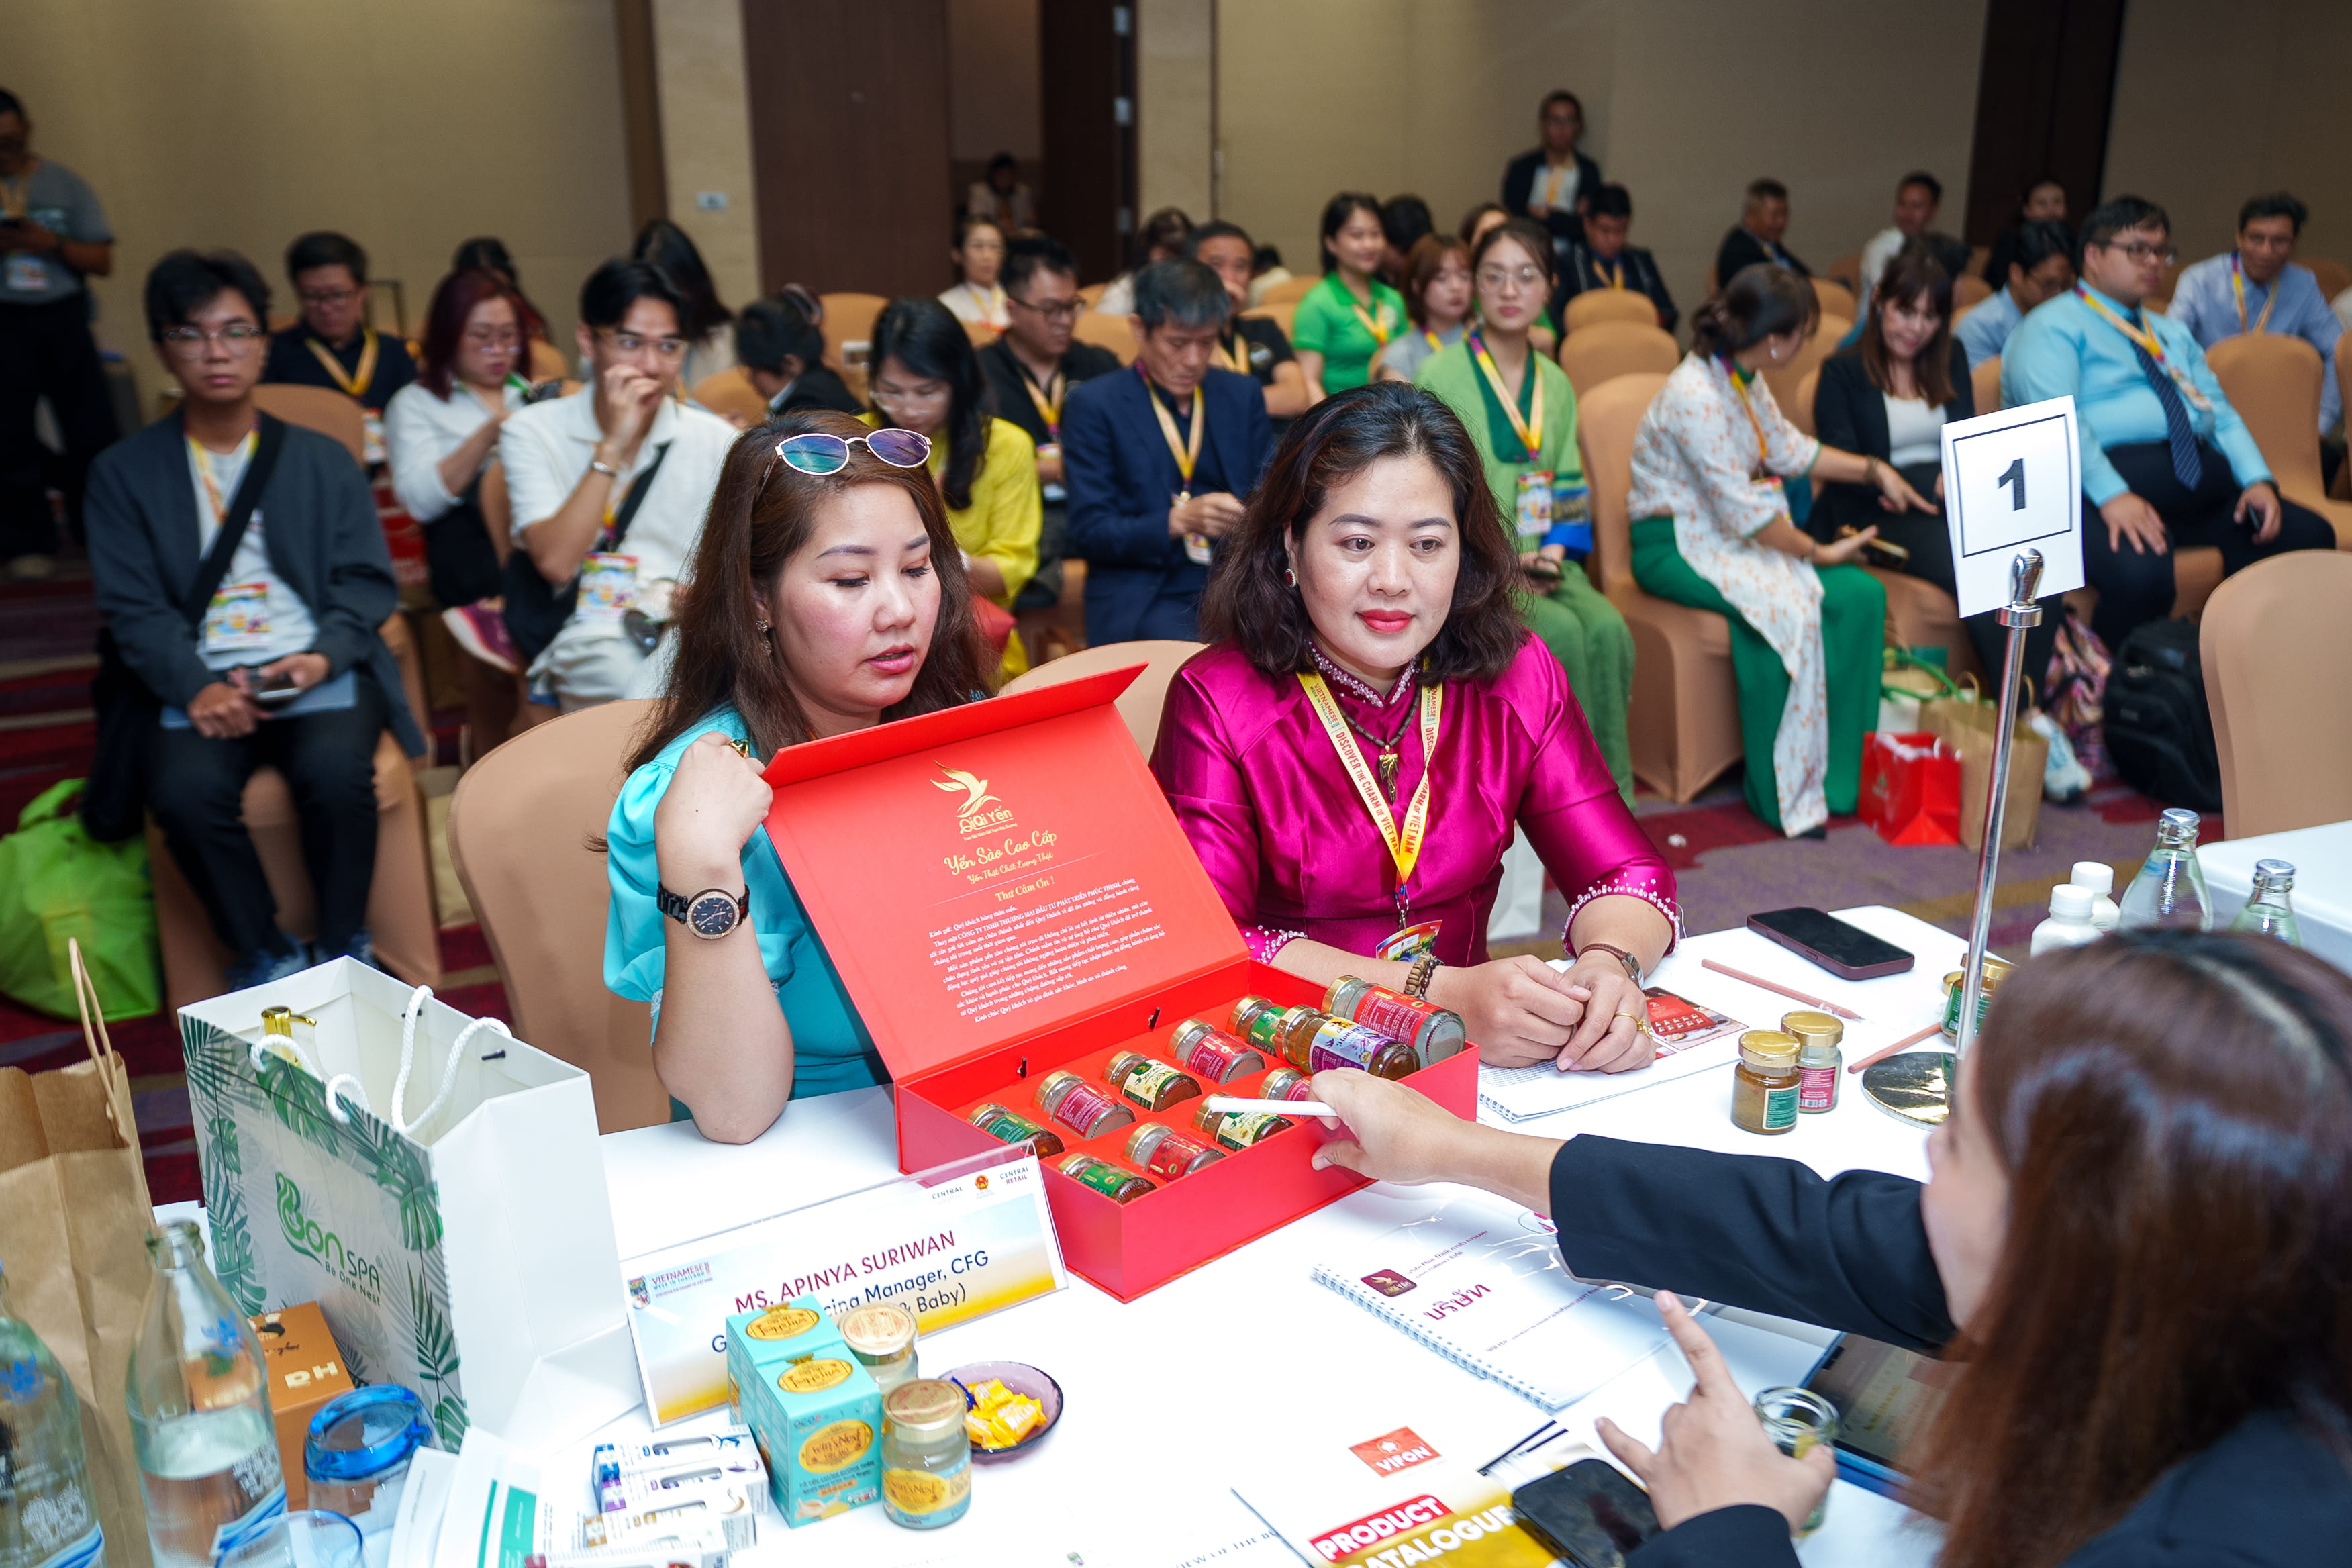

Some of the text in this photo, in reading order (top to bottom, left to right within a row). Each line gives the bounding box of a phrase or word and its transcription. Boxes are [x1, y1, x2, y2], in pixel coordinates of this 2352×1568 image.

[1998, 458, 2025, 511] 1
[1314, 683, 1338, 723] VIETNAMESE
[1336, 732, 1361, 770] DISCOVER
[1355, 768, 1366, 781] THE
[1362, 781, 1377, 809] CHARM
[1376, 807, 1384, 816] OF
[944, 855, 975, 875] Yến
[977, 847, 1003, 864] Sào
[1004, 838, 1030, 855] Cao
[1031, 830, 1057, 846] Cấp
[1403, 834, 1416, 854] NAM
[967, 873, 983, 884] Yến
[995, 891, 1015, 901] Thư
[1015, 883, 1035, 895] Cảm
[932, 1187, 963, 1199] CENTRAL
[1006, 1175, 1028, 1185] RETAIL
[325, 1261, 380, 1306] Be One Nest
[347, 1250, 381, 1293] SPA
[652, 1263, 703, 1285] VIETNAMESE
[735, 1230, 956, 1314] MS. APINYA SURIWAN
[865, 1268, 947, 1305] Manager,
[950, 1250, 989, 1274] CFG
[917, 1283, 967, 1313] Baby)
[1423, 1283, 1491, 1320] บริษัท
[1375, 1444, 1432, 1471] VIFON
[1312, 1496, 1444, 1561] PRODUCT
[1344, 1504, 1516, 1568] ATALOGUE
